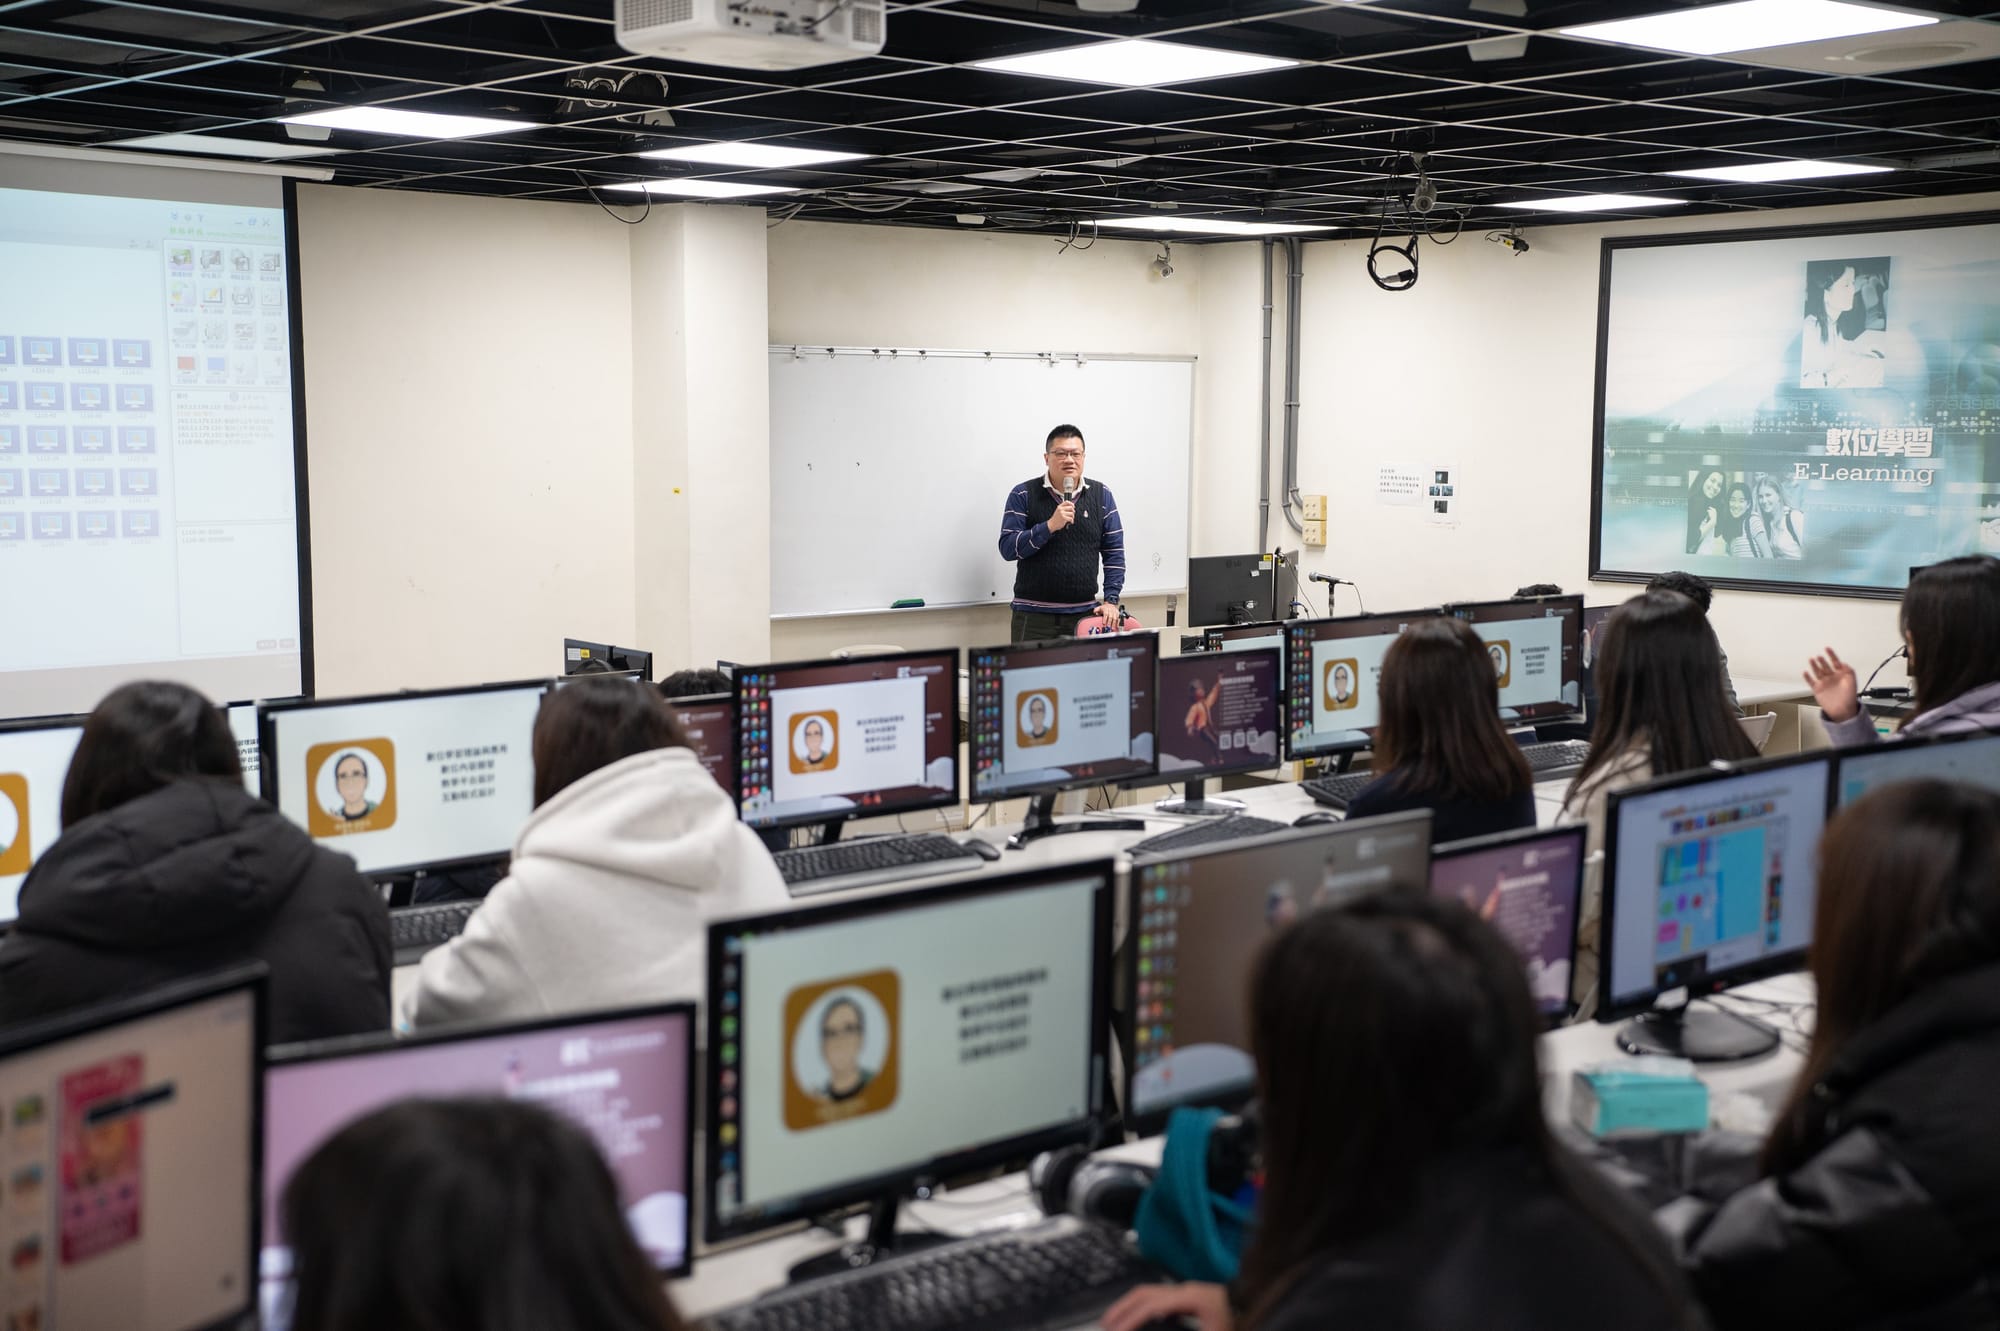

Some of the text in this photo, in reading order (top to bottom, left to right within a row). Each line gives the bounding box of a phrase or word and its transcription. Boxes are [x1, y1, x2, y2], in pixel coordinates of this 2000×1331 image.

[1825, 427, 1934, 457] 數位學習
[1793, 463, 1935, 486] E-Learning
